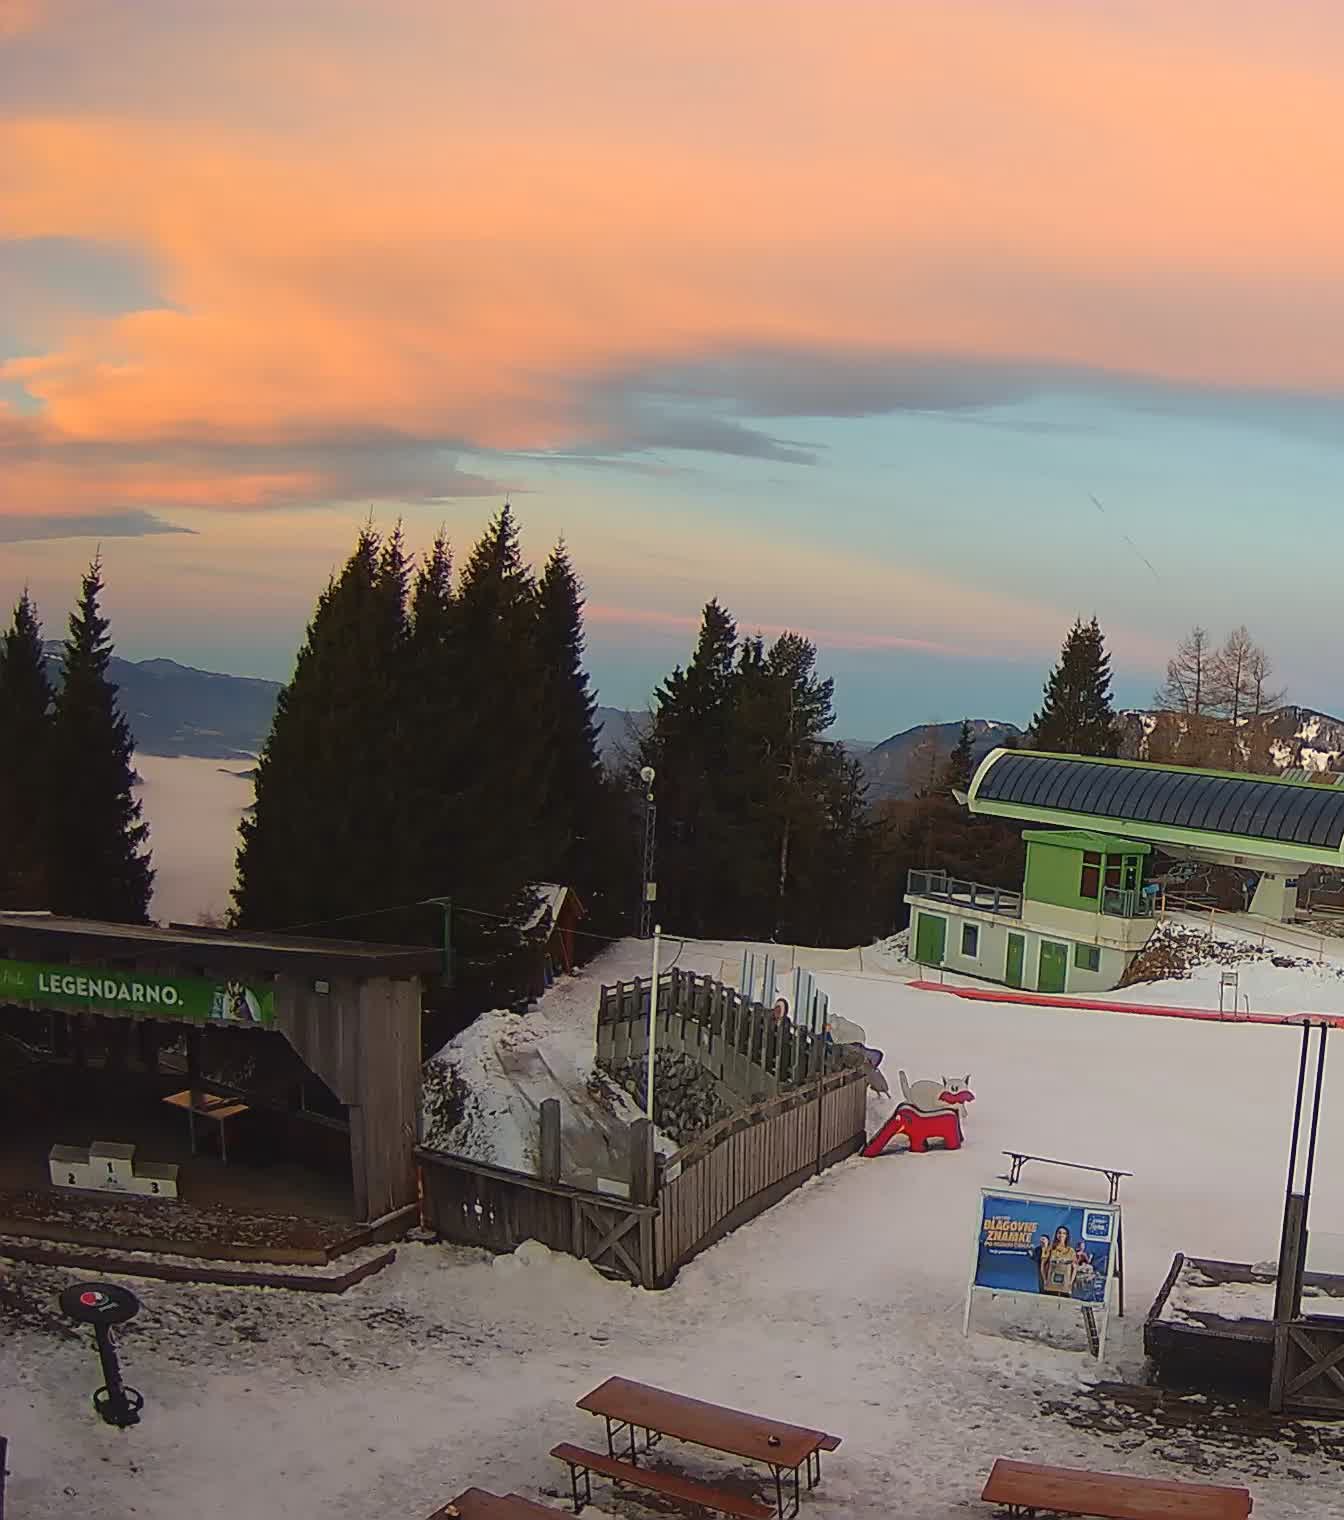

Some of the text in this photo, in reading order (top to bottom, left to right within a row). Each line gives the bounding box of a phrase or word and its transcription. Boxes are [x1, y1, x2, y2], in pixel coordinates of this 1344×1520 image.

[38, 973, 184, 1006] LEGENDARNO.
[106, 1161, 114, 1174] 1
[68, 1172, 76, 1185] 2
[151, 1181, 160, 1194] 3
